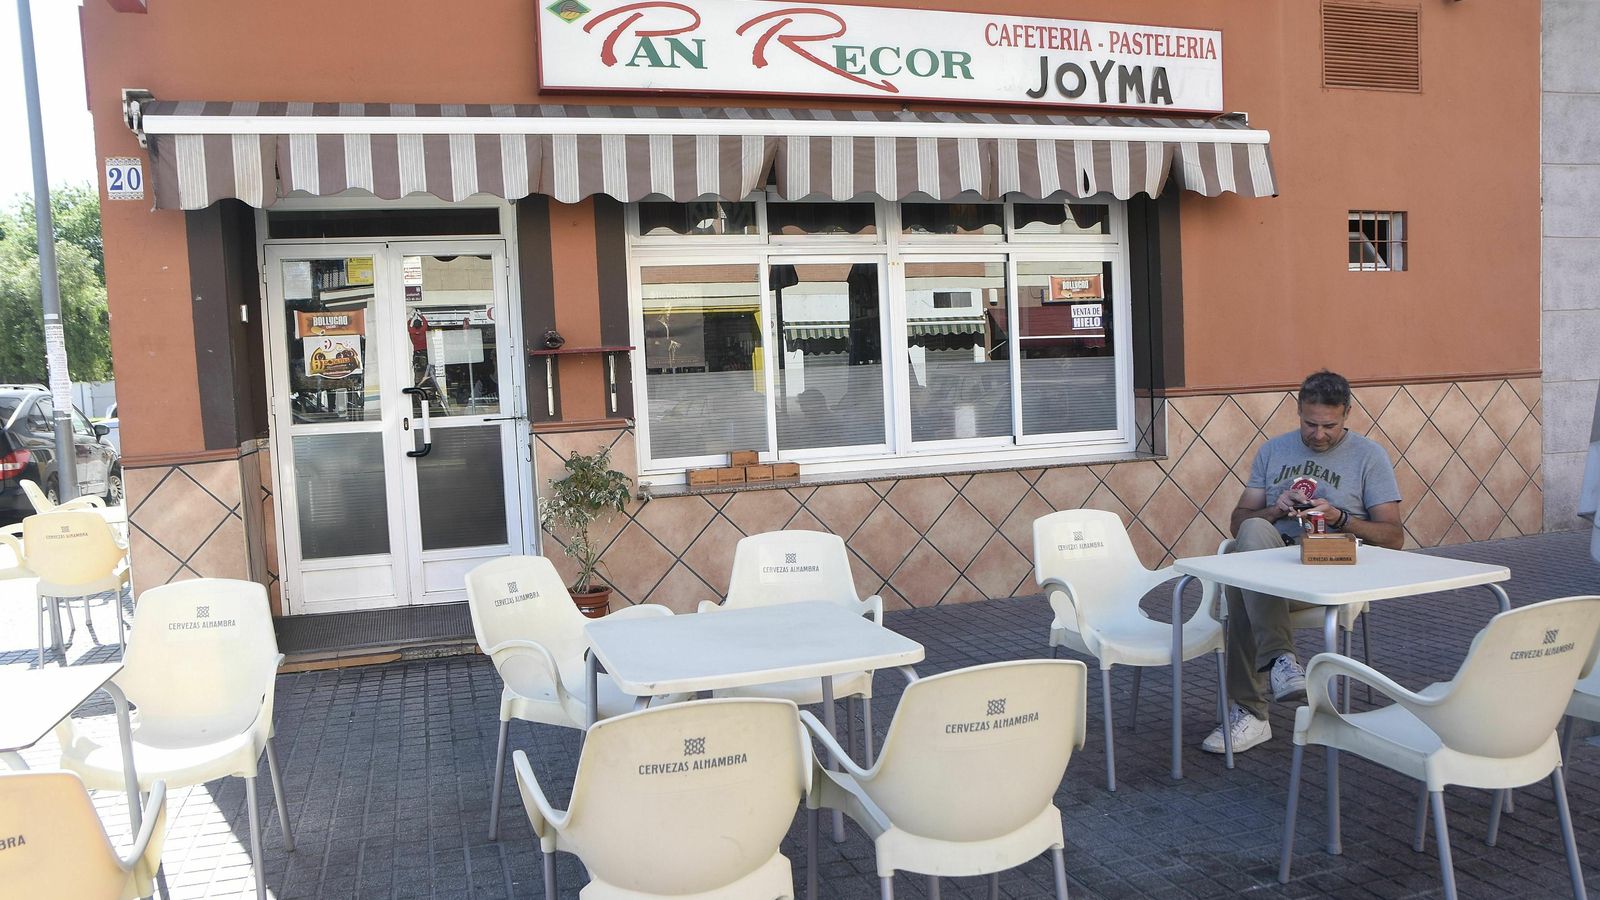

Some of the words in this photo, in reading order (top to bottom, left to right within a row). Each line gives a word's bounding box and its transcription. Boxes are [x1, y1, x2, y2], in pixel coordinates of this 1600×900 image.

[583, 1, 708, 69] PAN
[736, 7, 974, 93] RECOR
[984, 22, 1093, 51] CAFETERIA
[1109, 30, 1218, 60] PASTELERIA
[1026, 56, 1174, 105] JOYMA
[109, 167, 141, 190] 20
[1072, 307, 1091, 316] VENTA
[1092, 306, 1101, 315] DE
[1073, 317, 1101, 327] HIELO
[1273, 464, 1303, 484] JIM
[1303, 460, 1342, 490] BEAM
[168, 621, 201, 630] CERVEZAS
[202, 619, 236, 628] ALHAMBRA
[1510, 649, 1544, 660] CERVEZAS
[1544, 642, 1575, 656] ALHAMBRA
[944, 721, 991, 734] CERVEZAS
[992, 712, 1039, 729] ALHAMBRA
[638, 761, 689, 775] CERVEZAS
[692, 753, 748, 770] ALHAMBRA
